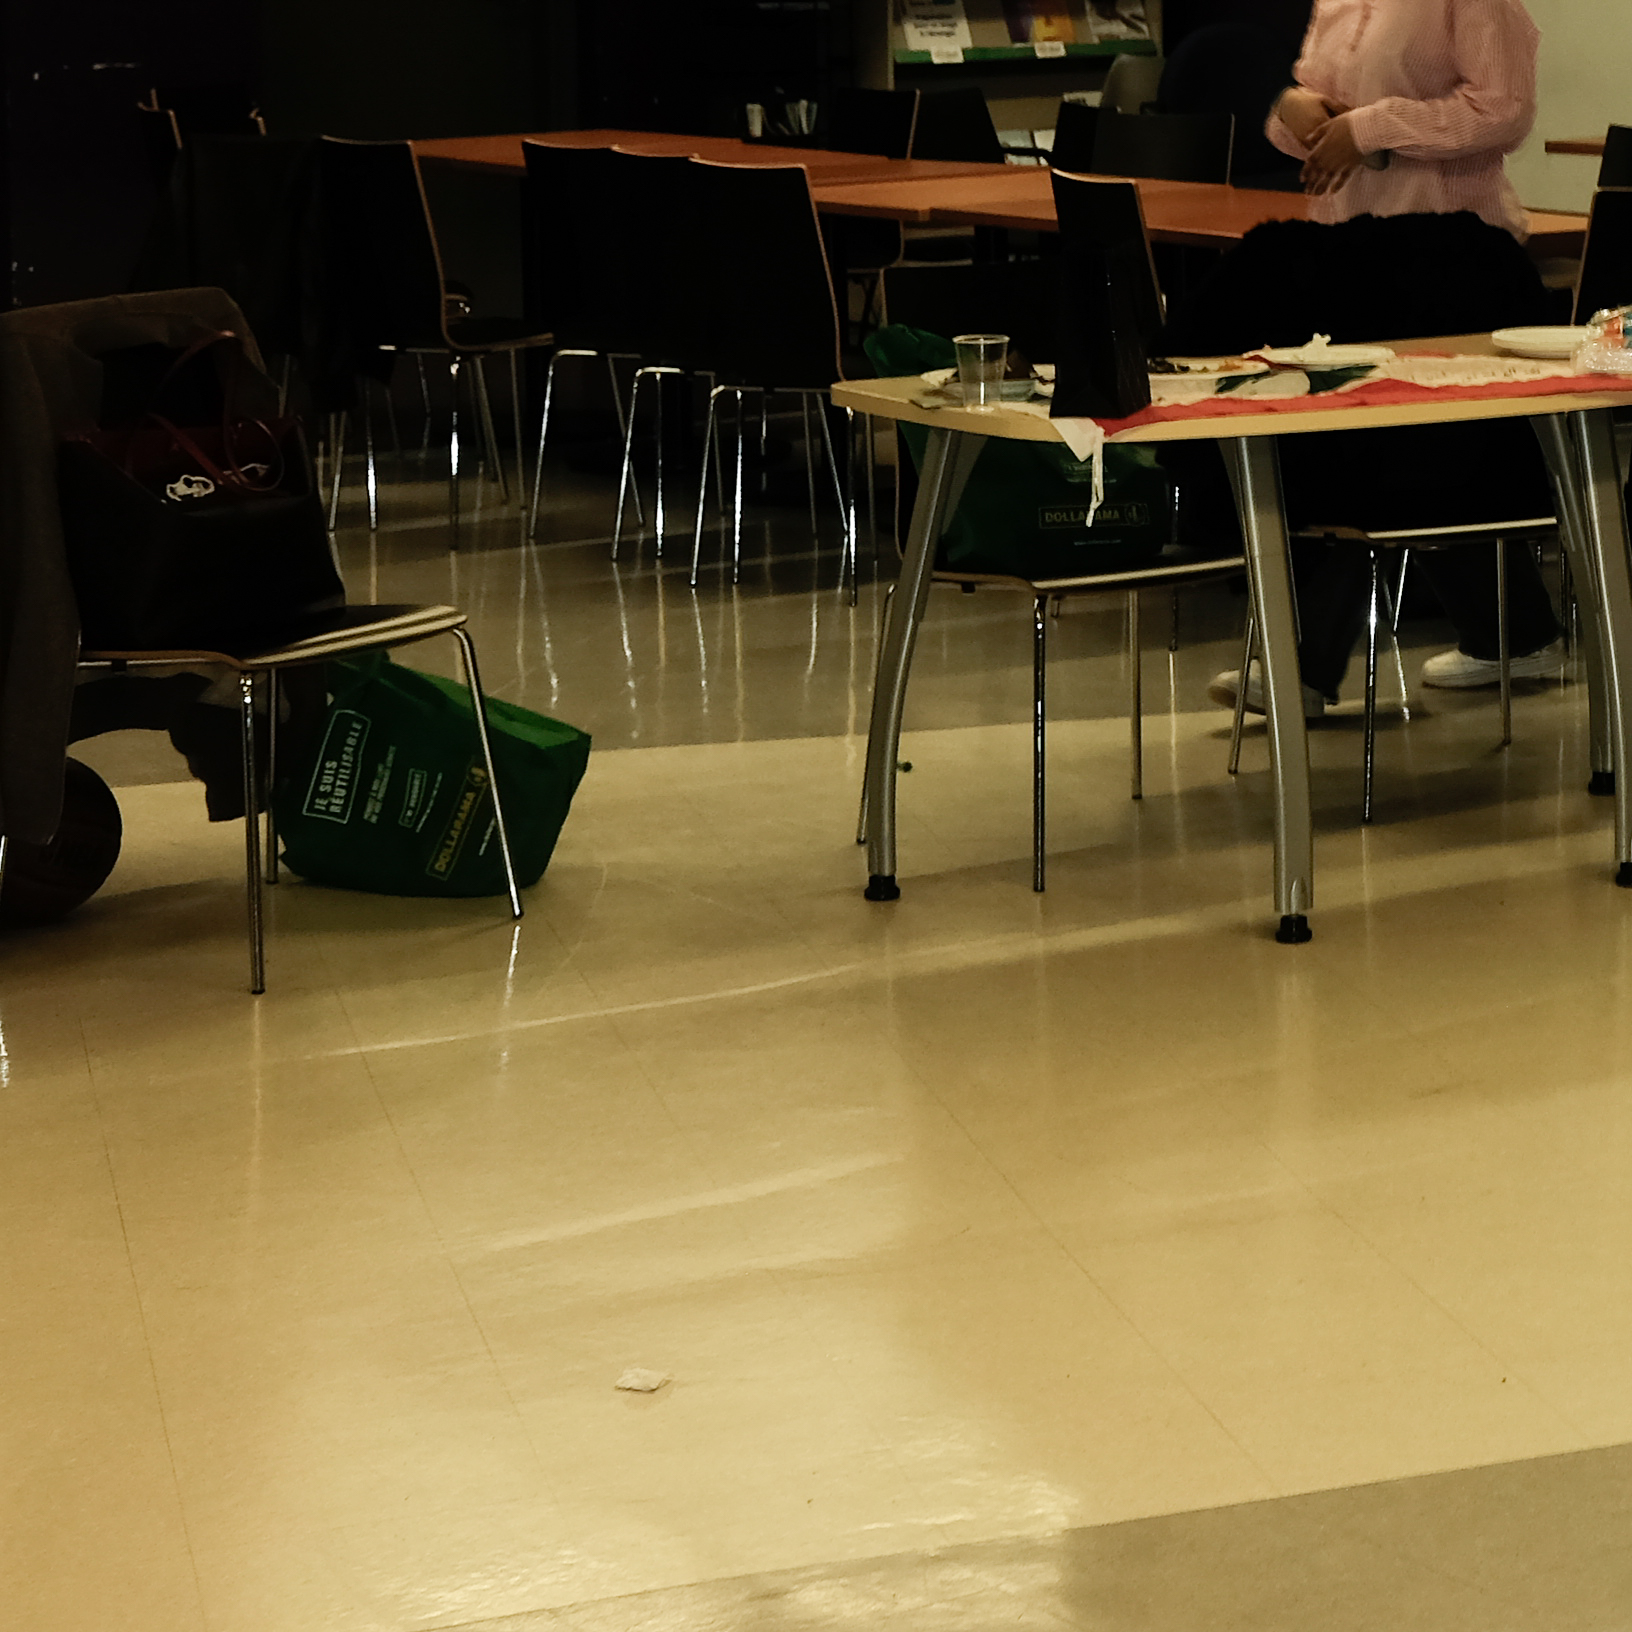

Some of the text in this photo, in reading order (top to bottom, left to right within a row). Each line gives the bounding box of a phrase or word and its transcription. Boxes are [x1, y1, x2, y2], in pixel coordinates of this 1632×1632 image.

[1045, 510, 1120, 522] DOLLAAMA
[314, 760, 338, 811] JE SUIS
[329, 721, 362, 813] RÉUTILISABLE
[434, 791, 477, 872] DOLLARAMA
